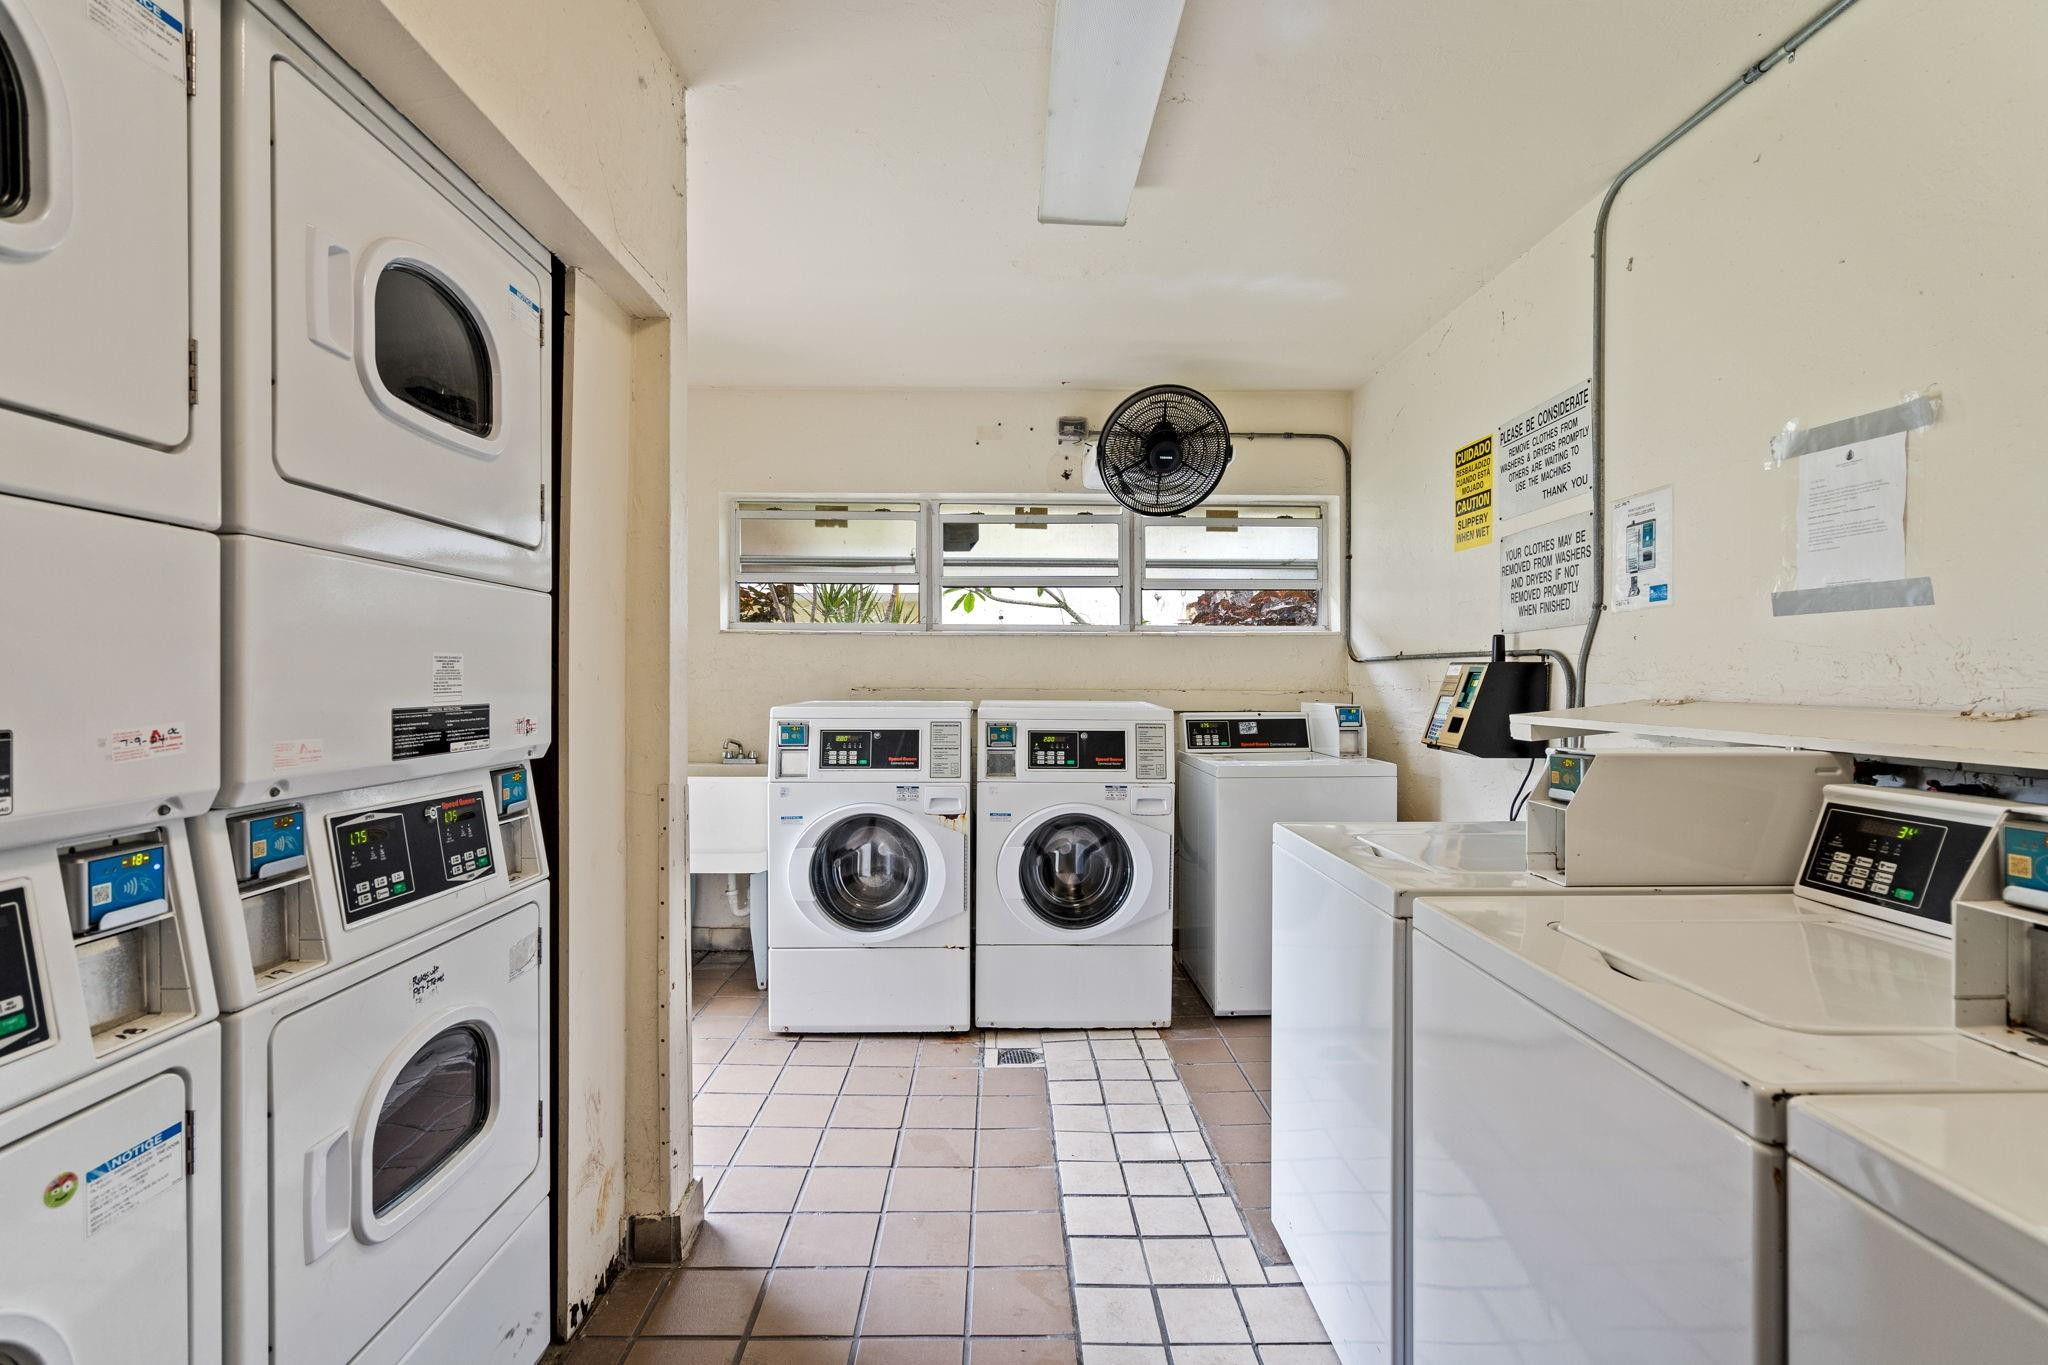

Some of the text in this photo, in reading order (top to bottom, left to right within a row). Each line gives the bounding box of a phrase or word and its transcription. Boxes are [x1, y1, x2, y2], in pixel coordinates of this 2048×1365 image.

[1500, 388, 1589, 446] PLEASE BE CONSIDERATE
[1500, 425, 1590, 474] WASHERS & DRYERS PROMPTLY
[1508, 417, 1578, 458] REMOVE CLOTHES FROM
[1456, 440, 1491, 465] CUIDADO
[1508, 444, 1580, 483] OTHERS ARE WAITING TO
[1456, 458, 1491, 478] RESBALADIZO
[1456, 473, 1477, 488] CUANDO
[1515, 462, 1572, 493] USE THE MACHINES
[1462, 481, 1484, 496] MOJADO
[1542, 474, 1589, 499] THANK YOU
[1456, 491, 1490, 514] CAUTION
[1457, 512, 1489, 531] SLIPPERY
[1456, 525, 1490, 544] WHEN WET
[1505, 529, 1586, 562] YOUR CLOTHES MAY BE
[1502, 544, 1592, 577] REMOVED FROM WASHERS
[1510, 564, 1580, 590] AND DRYERS IF NOT
[1510, 580, 1580, 604] REMOVED PROMPTLY
[1518, 598, 1571, 617] WHEN FINISHED
[111, 1133, 163, 1169] NOTICE
